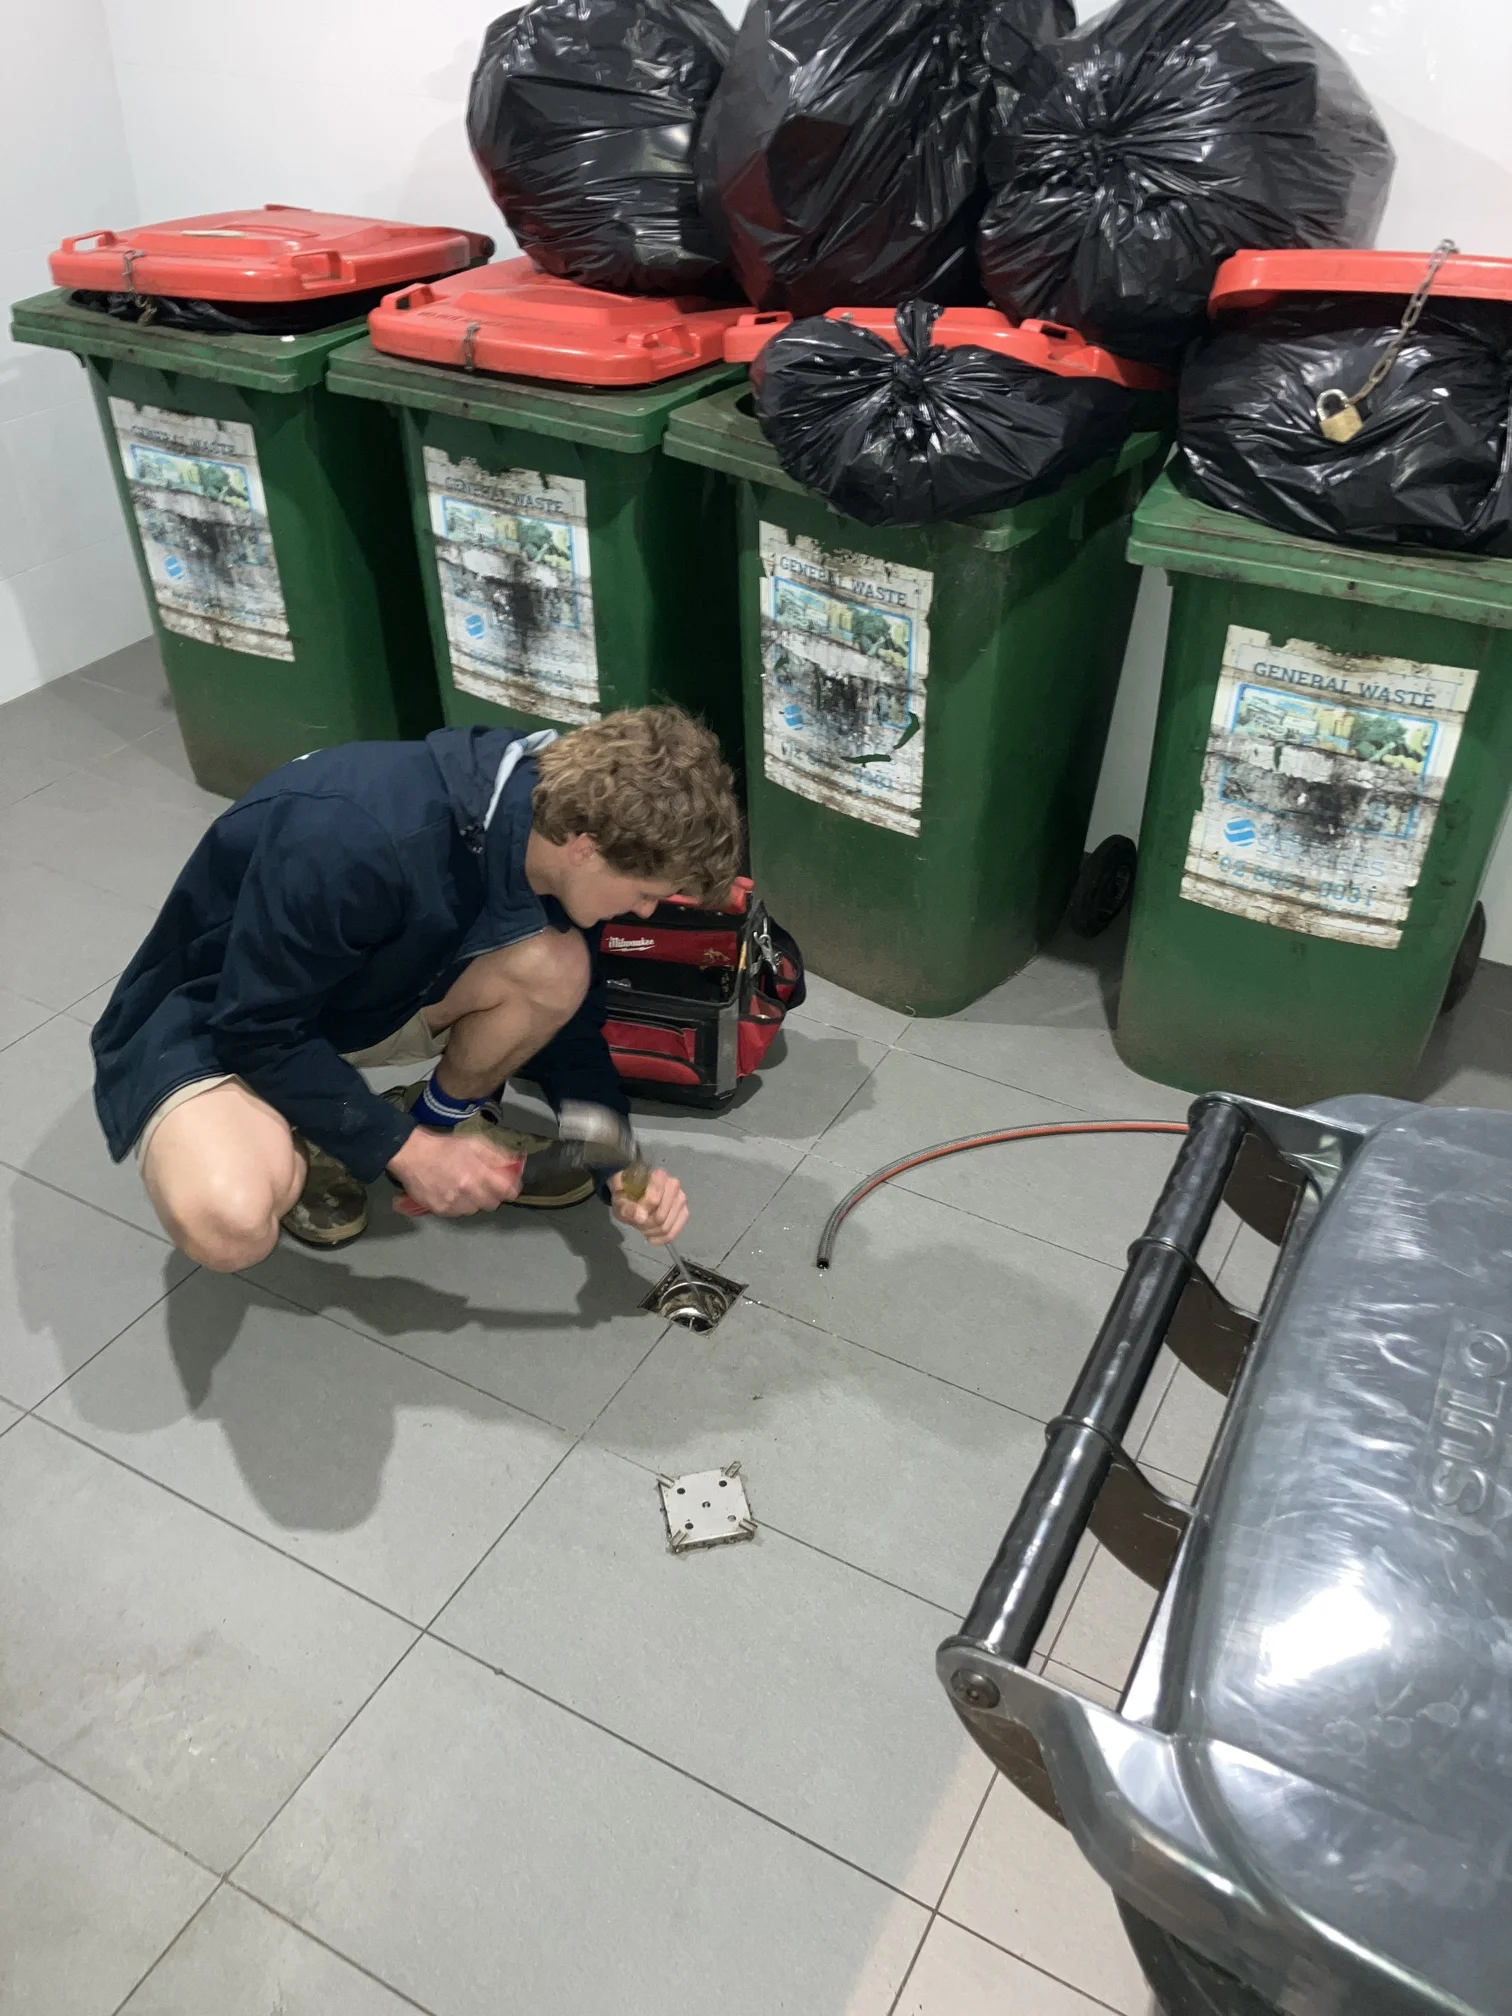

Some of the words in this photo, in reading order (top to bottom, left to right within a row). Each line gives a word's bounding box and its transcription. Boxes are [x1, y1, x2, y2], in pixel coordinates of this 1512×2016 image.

[851, 579, 908, 606] WASTE
[1253, 661, 1350, 694] GENERAL
[1358, 681, 1436, 709] WASTE
[605, 936, 655, 949] Milwaukee
[1432, 1330, 1511, 1515] SULO
